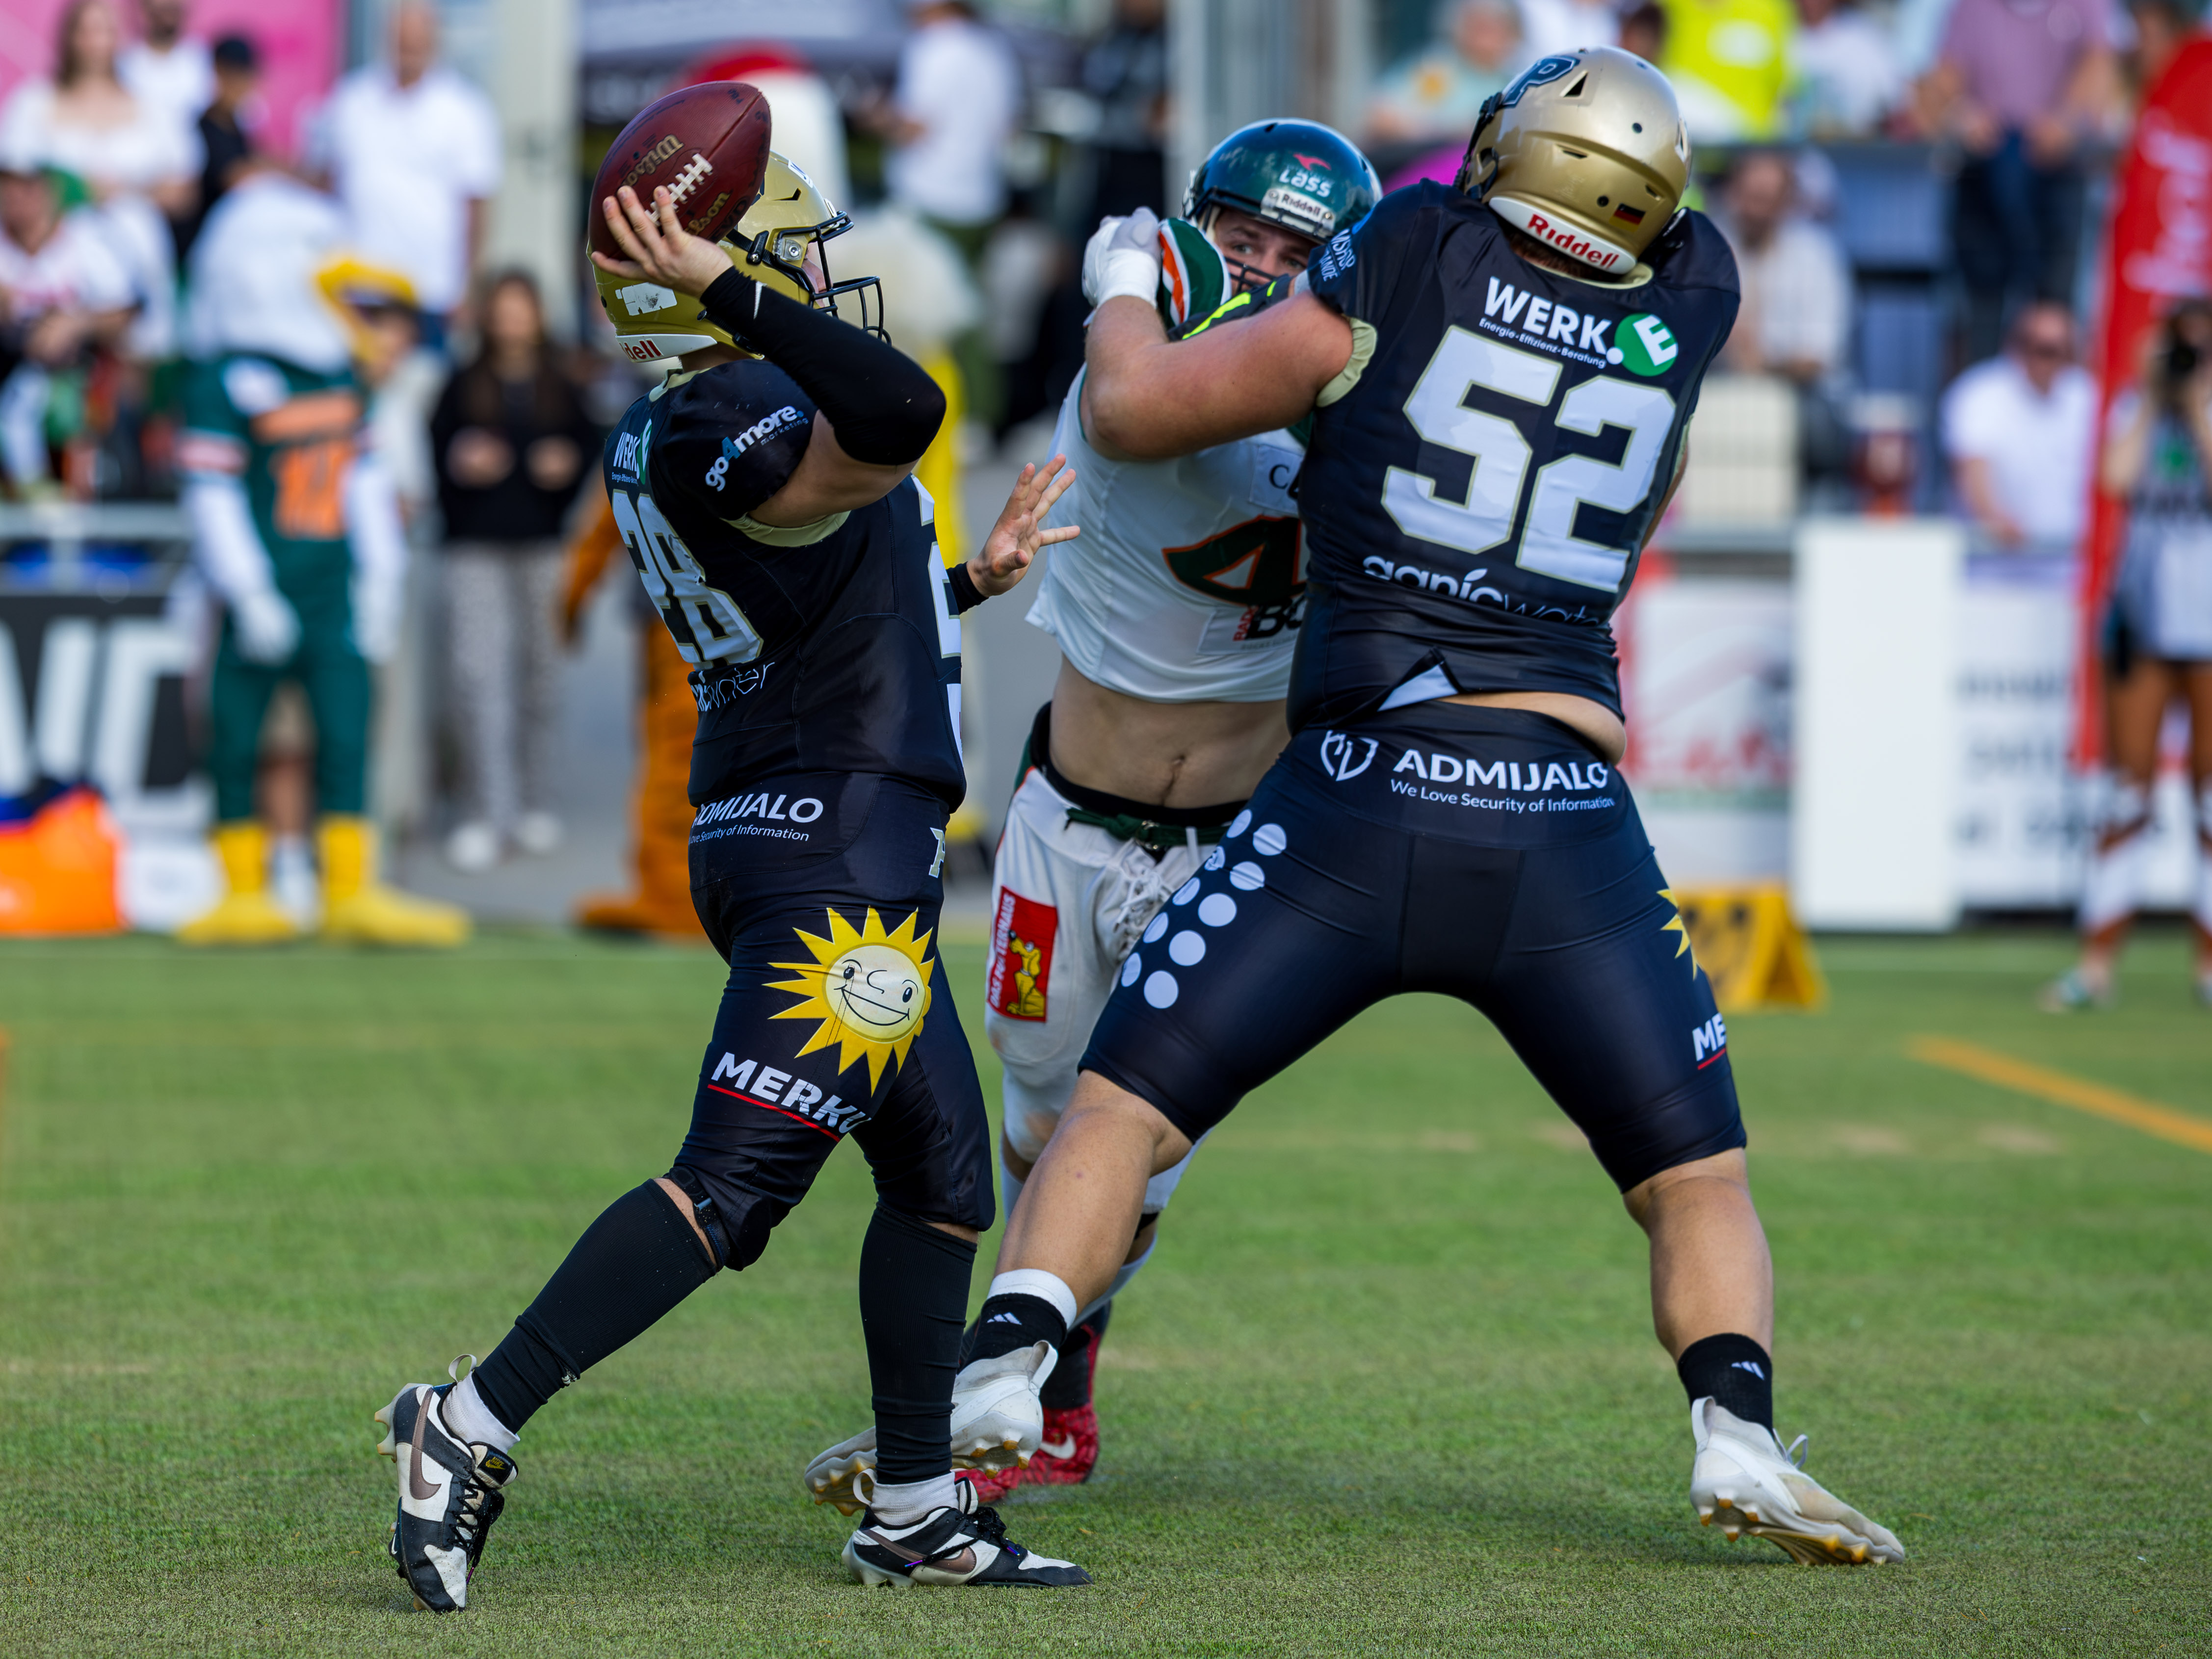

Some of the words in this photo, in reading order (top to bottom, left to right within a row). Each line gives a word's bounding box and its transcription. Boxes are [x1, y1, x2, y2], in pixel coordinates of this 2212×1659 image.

[1527, 213, 1620, 268] Riddell
[761, 418, 809, 446] marketing
[1380, 324, 1677, 593] 52
[612, 489, 764, 669] 28
[1393, 749, 1608, 791] ADMIJALO
[1391, 779, 1417, 797] We
[1421, 787, 1458, 804] Love
[1460, 792, 1527, 814] Security
[1528, 799, 1546, 812] of
[1548, 796, 1614, 812] Information
[700, 828, 726, 842] Security
[726, 824, 738, 836] of
[737, 824, 810, 842] Information
[711, 1052, 872, 1133] MERKU
[491, 1456, 504, 1467] NIKE
